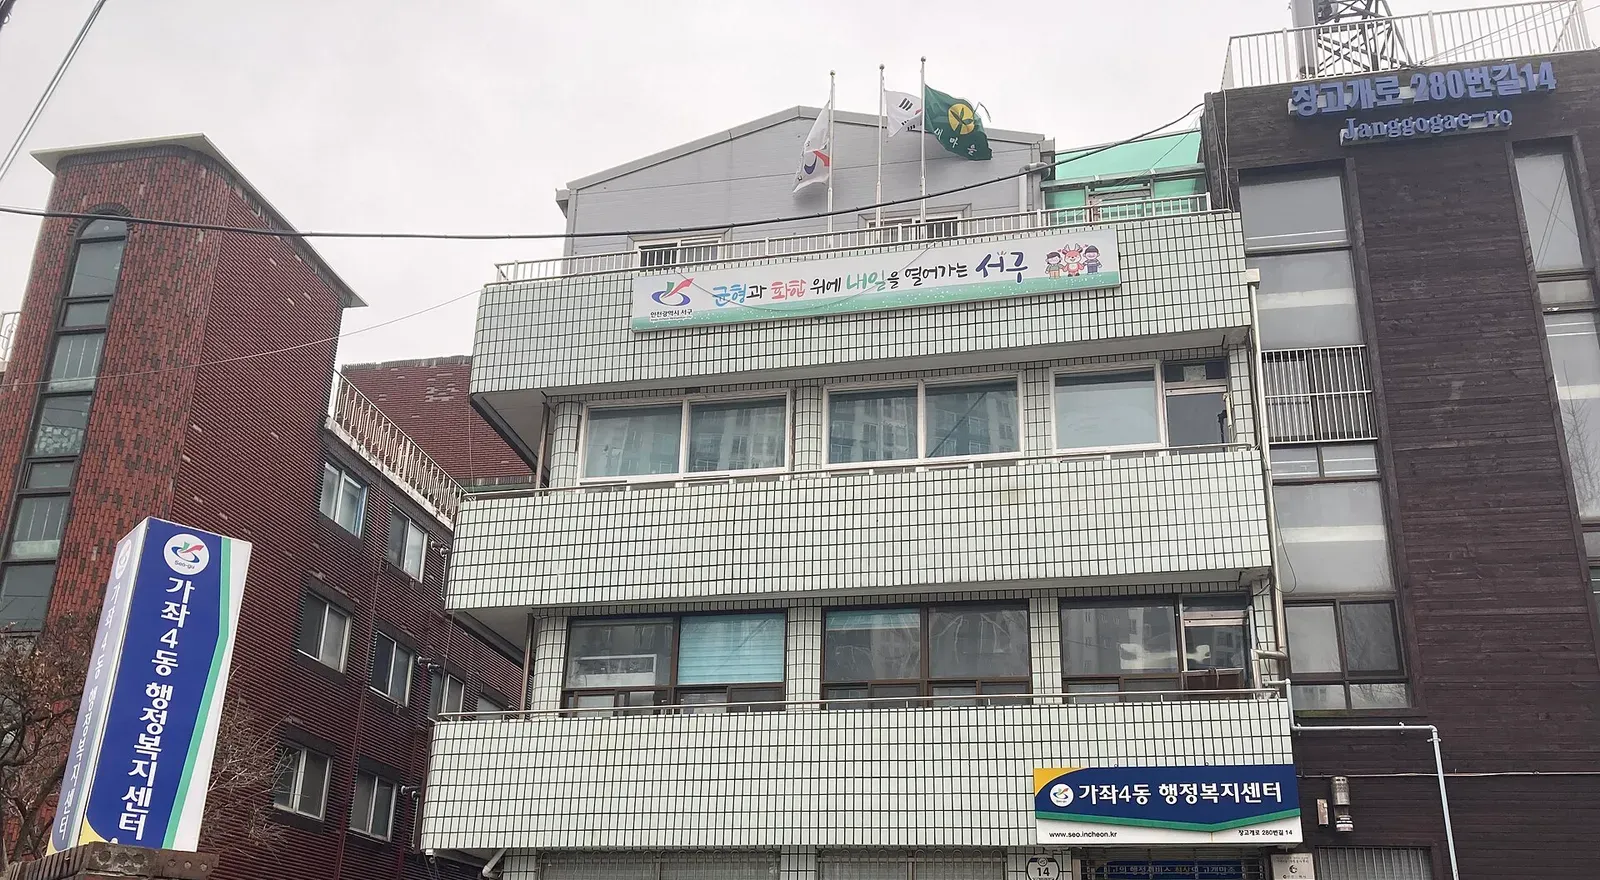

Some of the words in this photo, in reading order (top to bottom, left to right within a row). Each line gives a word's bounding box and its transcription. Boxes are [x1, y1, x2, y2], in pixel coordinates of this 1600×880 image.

[1291, 75, 1403, 117] 장고개로
[1343, 107, 1513, 140] Janggogae-ro
[712, 283, 767, 307] 균형과
[771, 279, 807, 300] 화합
[810, 277, 842, 295] 위에
[846, 270, 900, 292] 내일을
[905, 263, 968, 287] 열어가는
[975, 251, 1028, 283] 서구
[650, 310, 680, 318] 인천광역시
[681, 308, 693, 316] 서구
[95, 582, 120, 680] 가좌4동
[151, 576, 195, 677] 가좌4동
[117, 681, 174, 842] 행정복지센터
[1078, 784, 1152, 805] 가좌4동
[1158, 782, 1282, 805] 행정복지센터
[1238, 829, 1260, 837] 장고개로
[1037, 867, 1050, 877] 14
